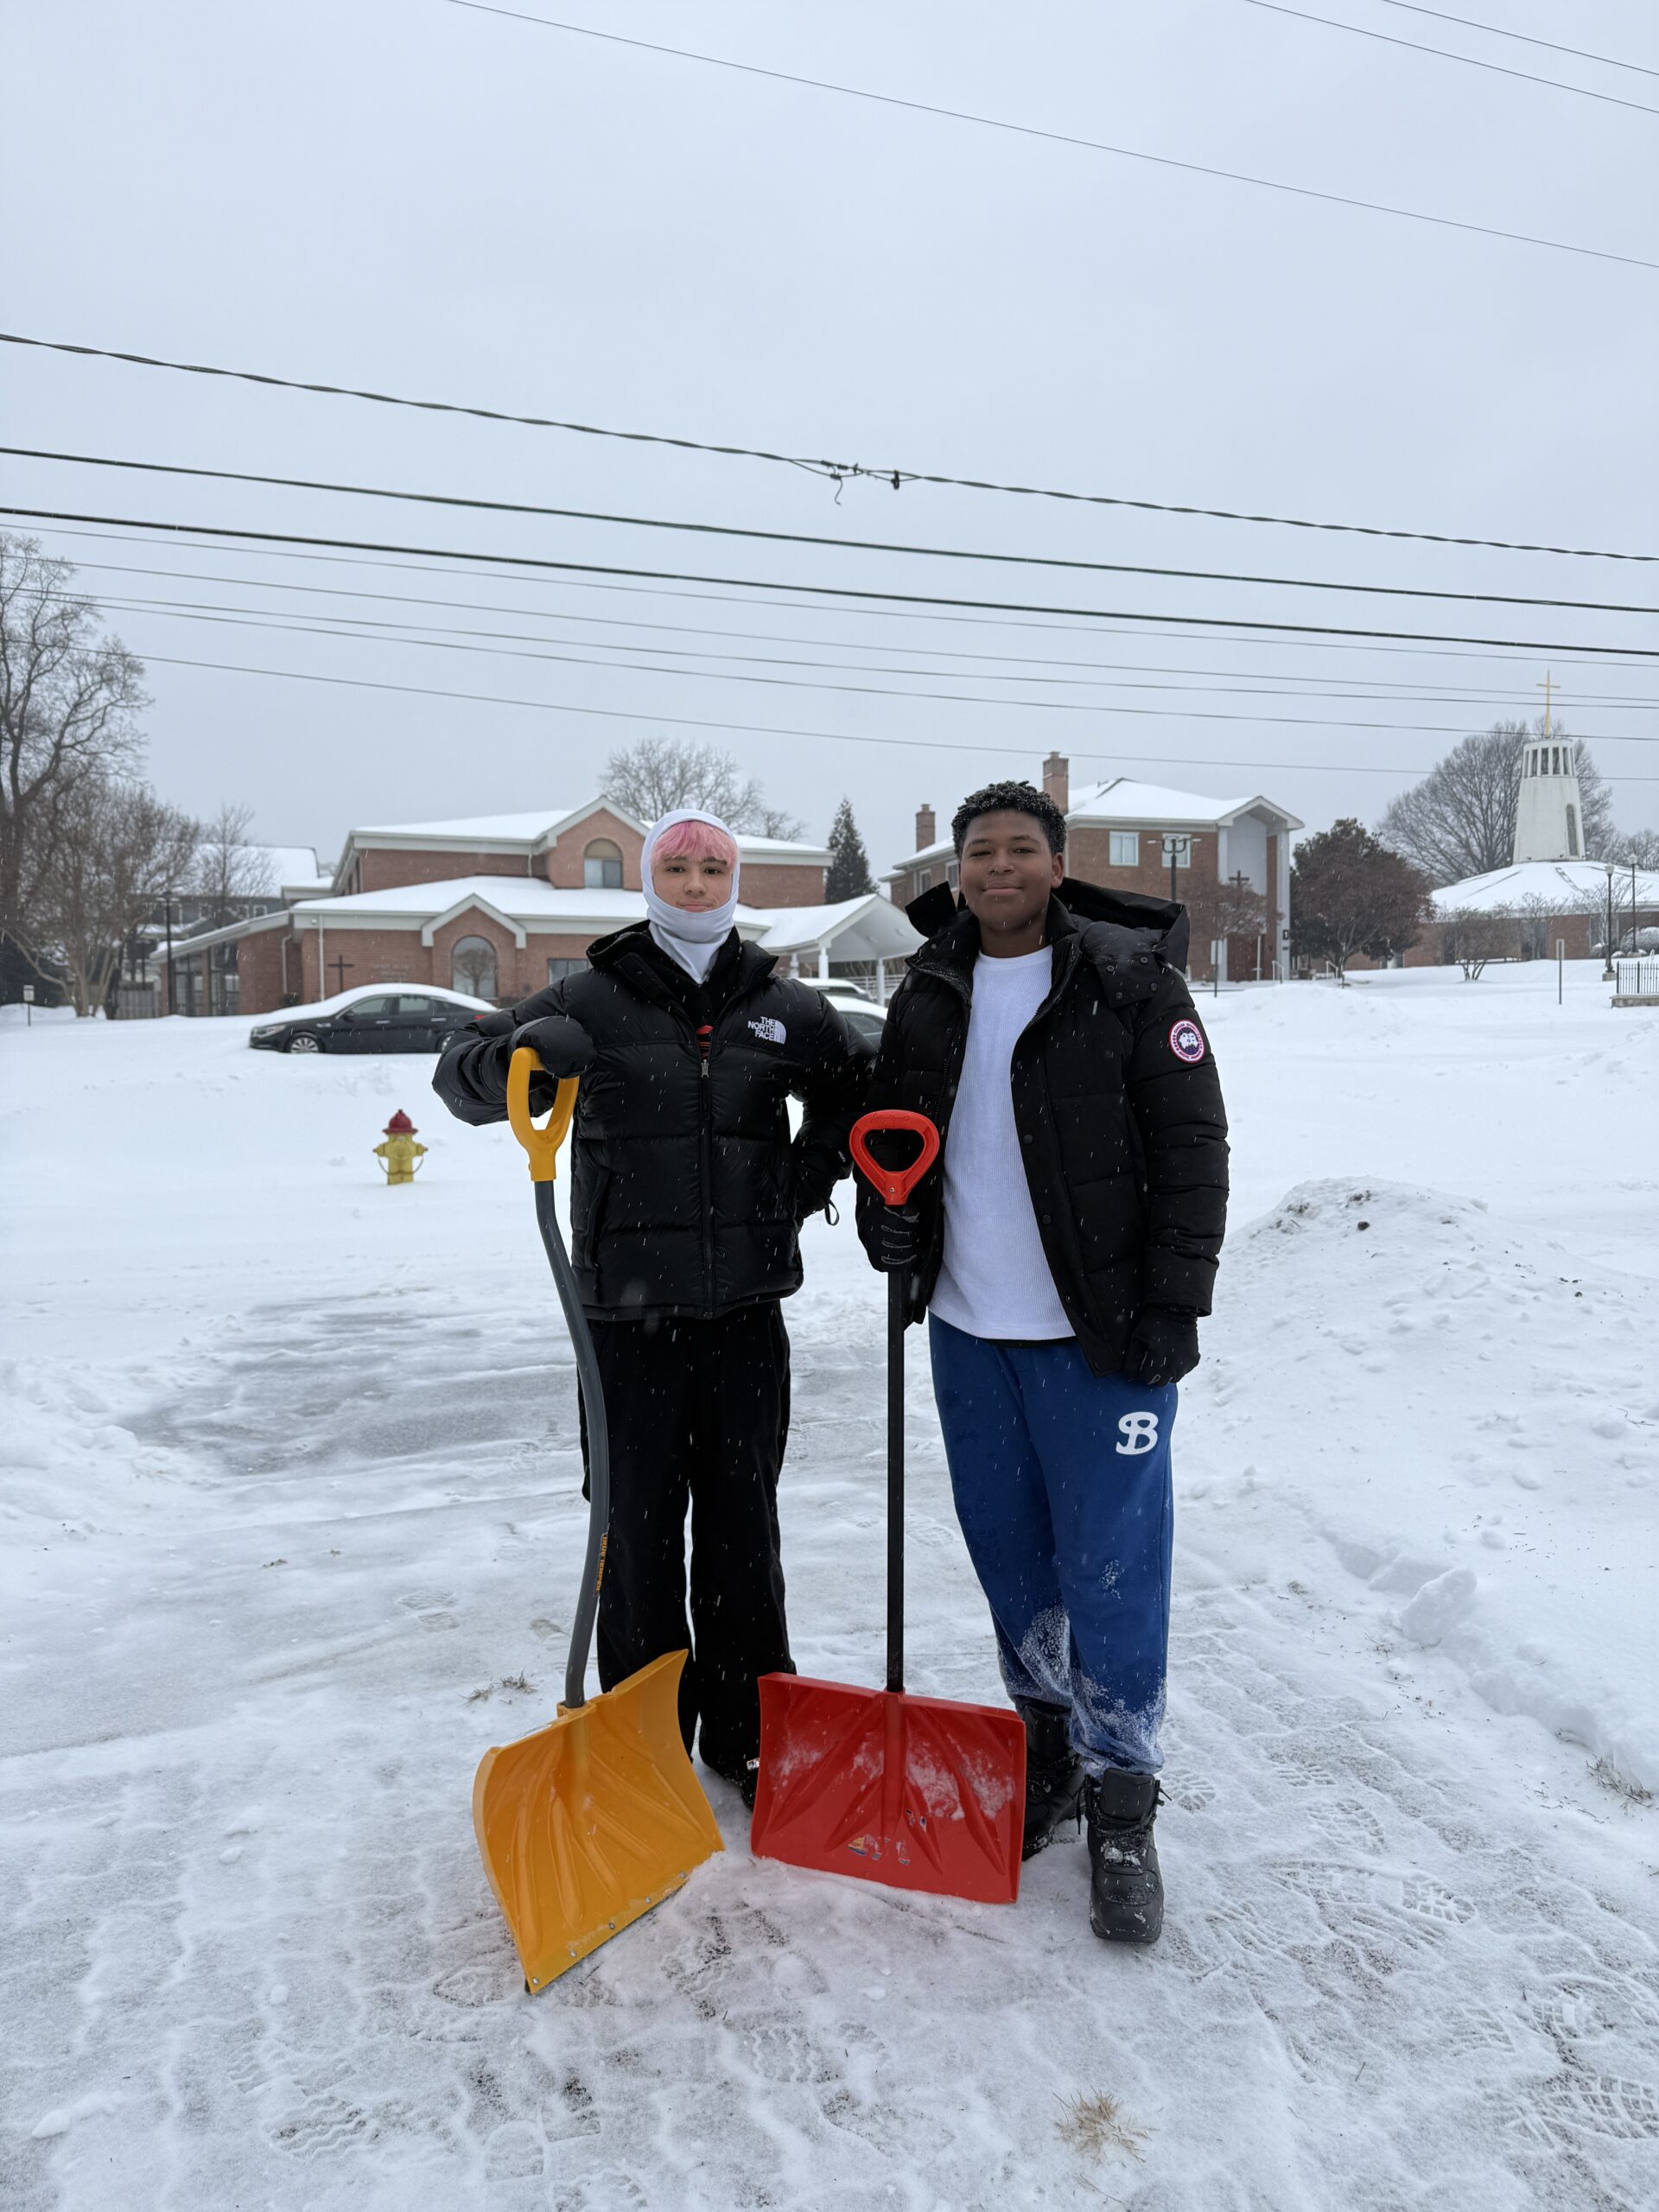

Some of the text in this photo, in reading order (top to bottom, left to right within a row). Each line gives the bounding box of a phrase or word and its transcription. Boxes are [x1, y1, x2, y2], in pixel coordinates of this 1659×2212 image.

[747, 1020, 775, 1033] NORTH
[760, 1016, 775, 1026] THE
[754, 1029, 774, 1041] FACE
